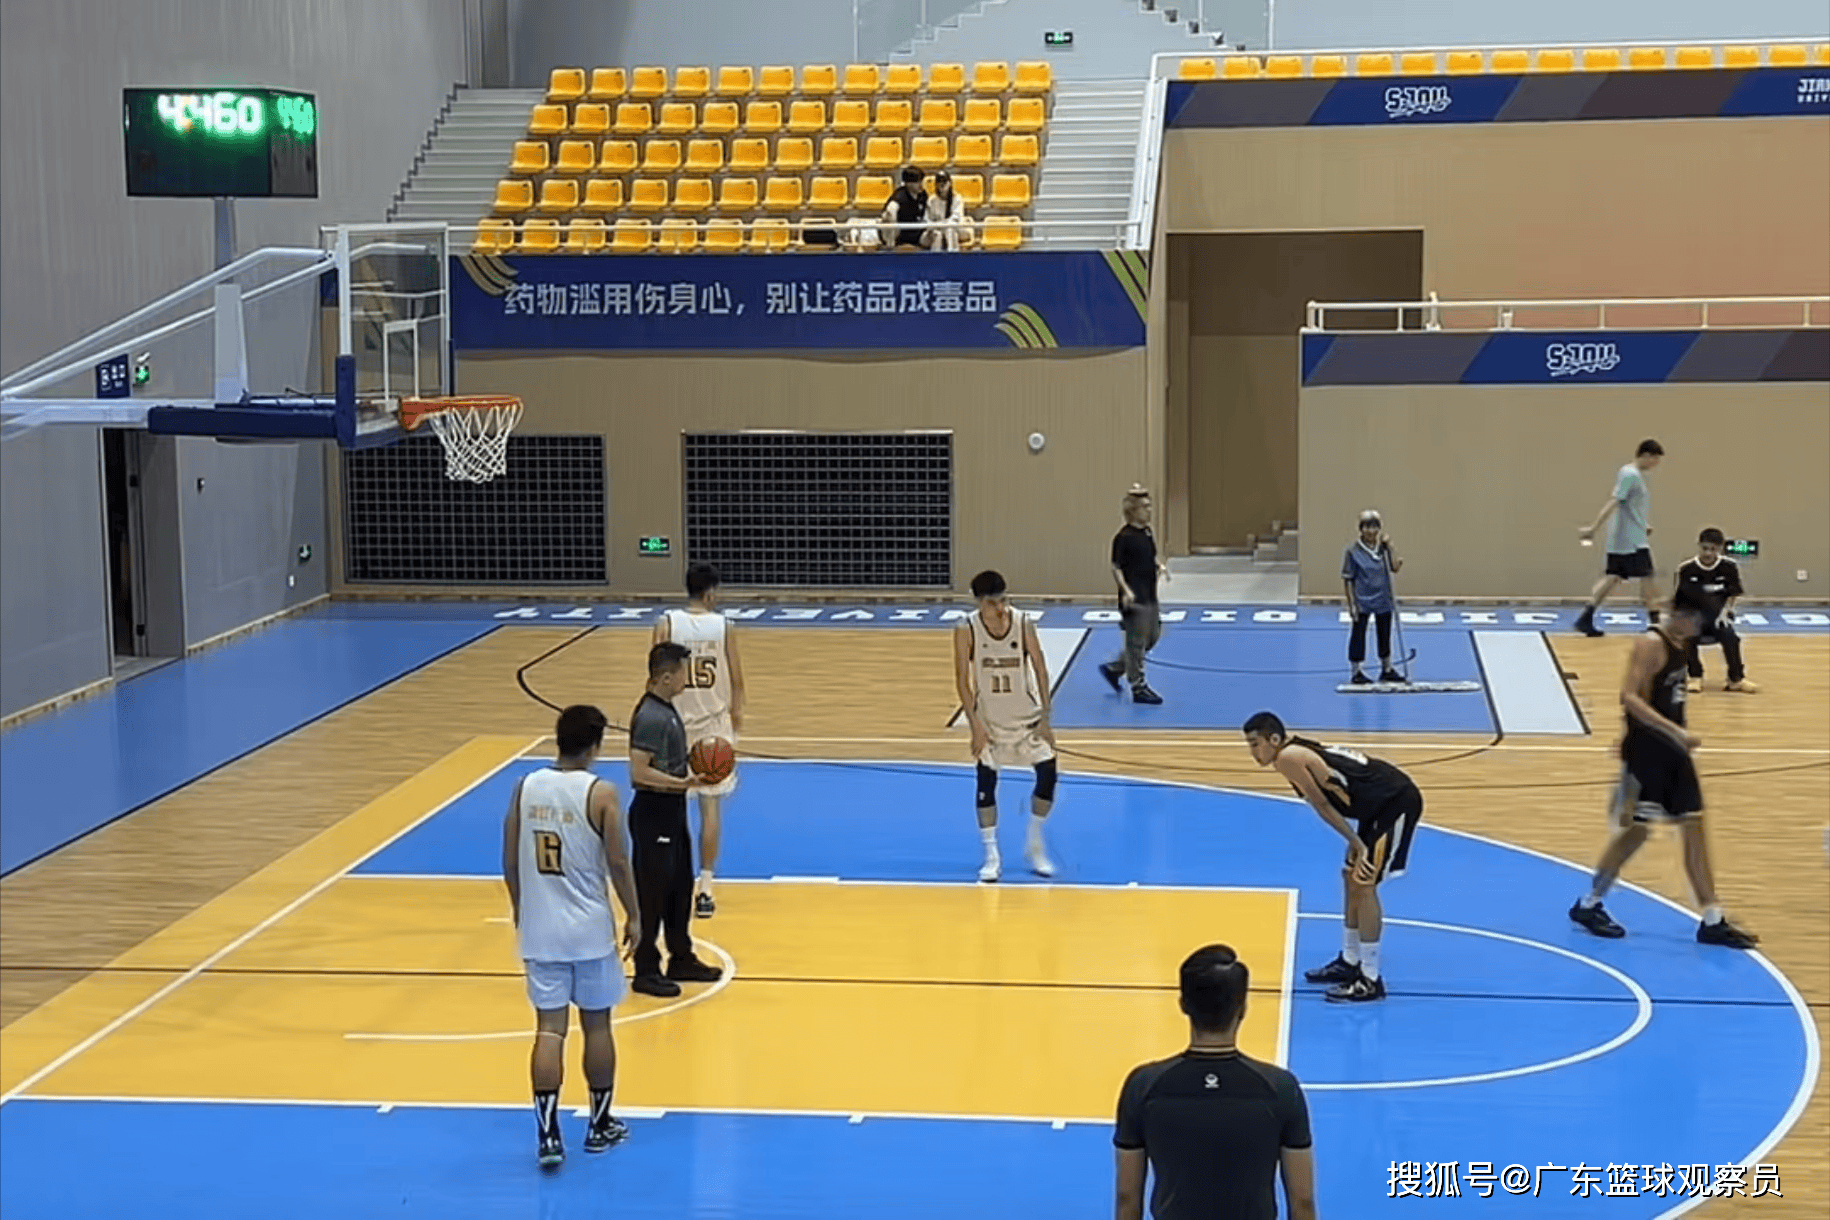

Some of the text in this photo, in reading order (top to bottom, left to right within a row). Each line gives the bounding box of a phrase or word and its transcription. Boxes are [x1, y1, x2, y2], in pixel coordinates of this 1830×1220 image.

[684, 656, 717, 688] 15
[992, 675, 1012, 693] 11
[533, 830, 564, 876] 6
